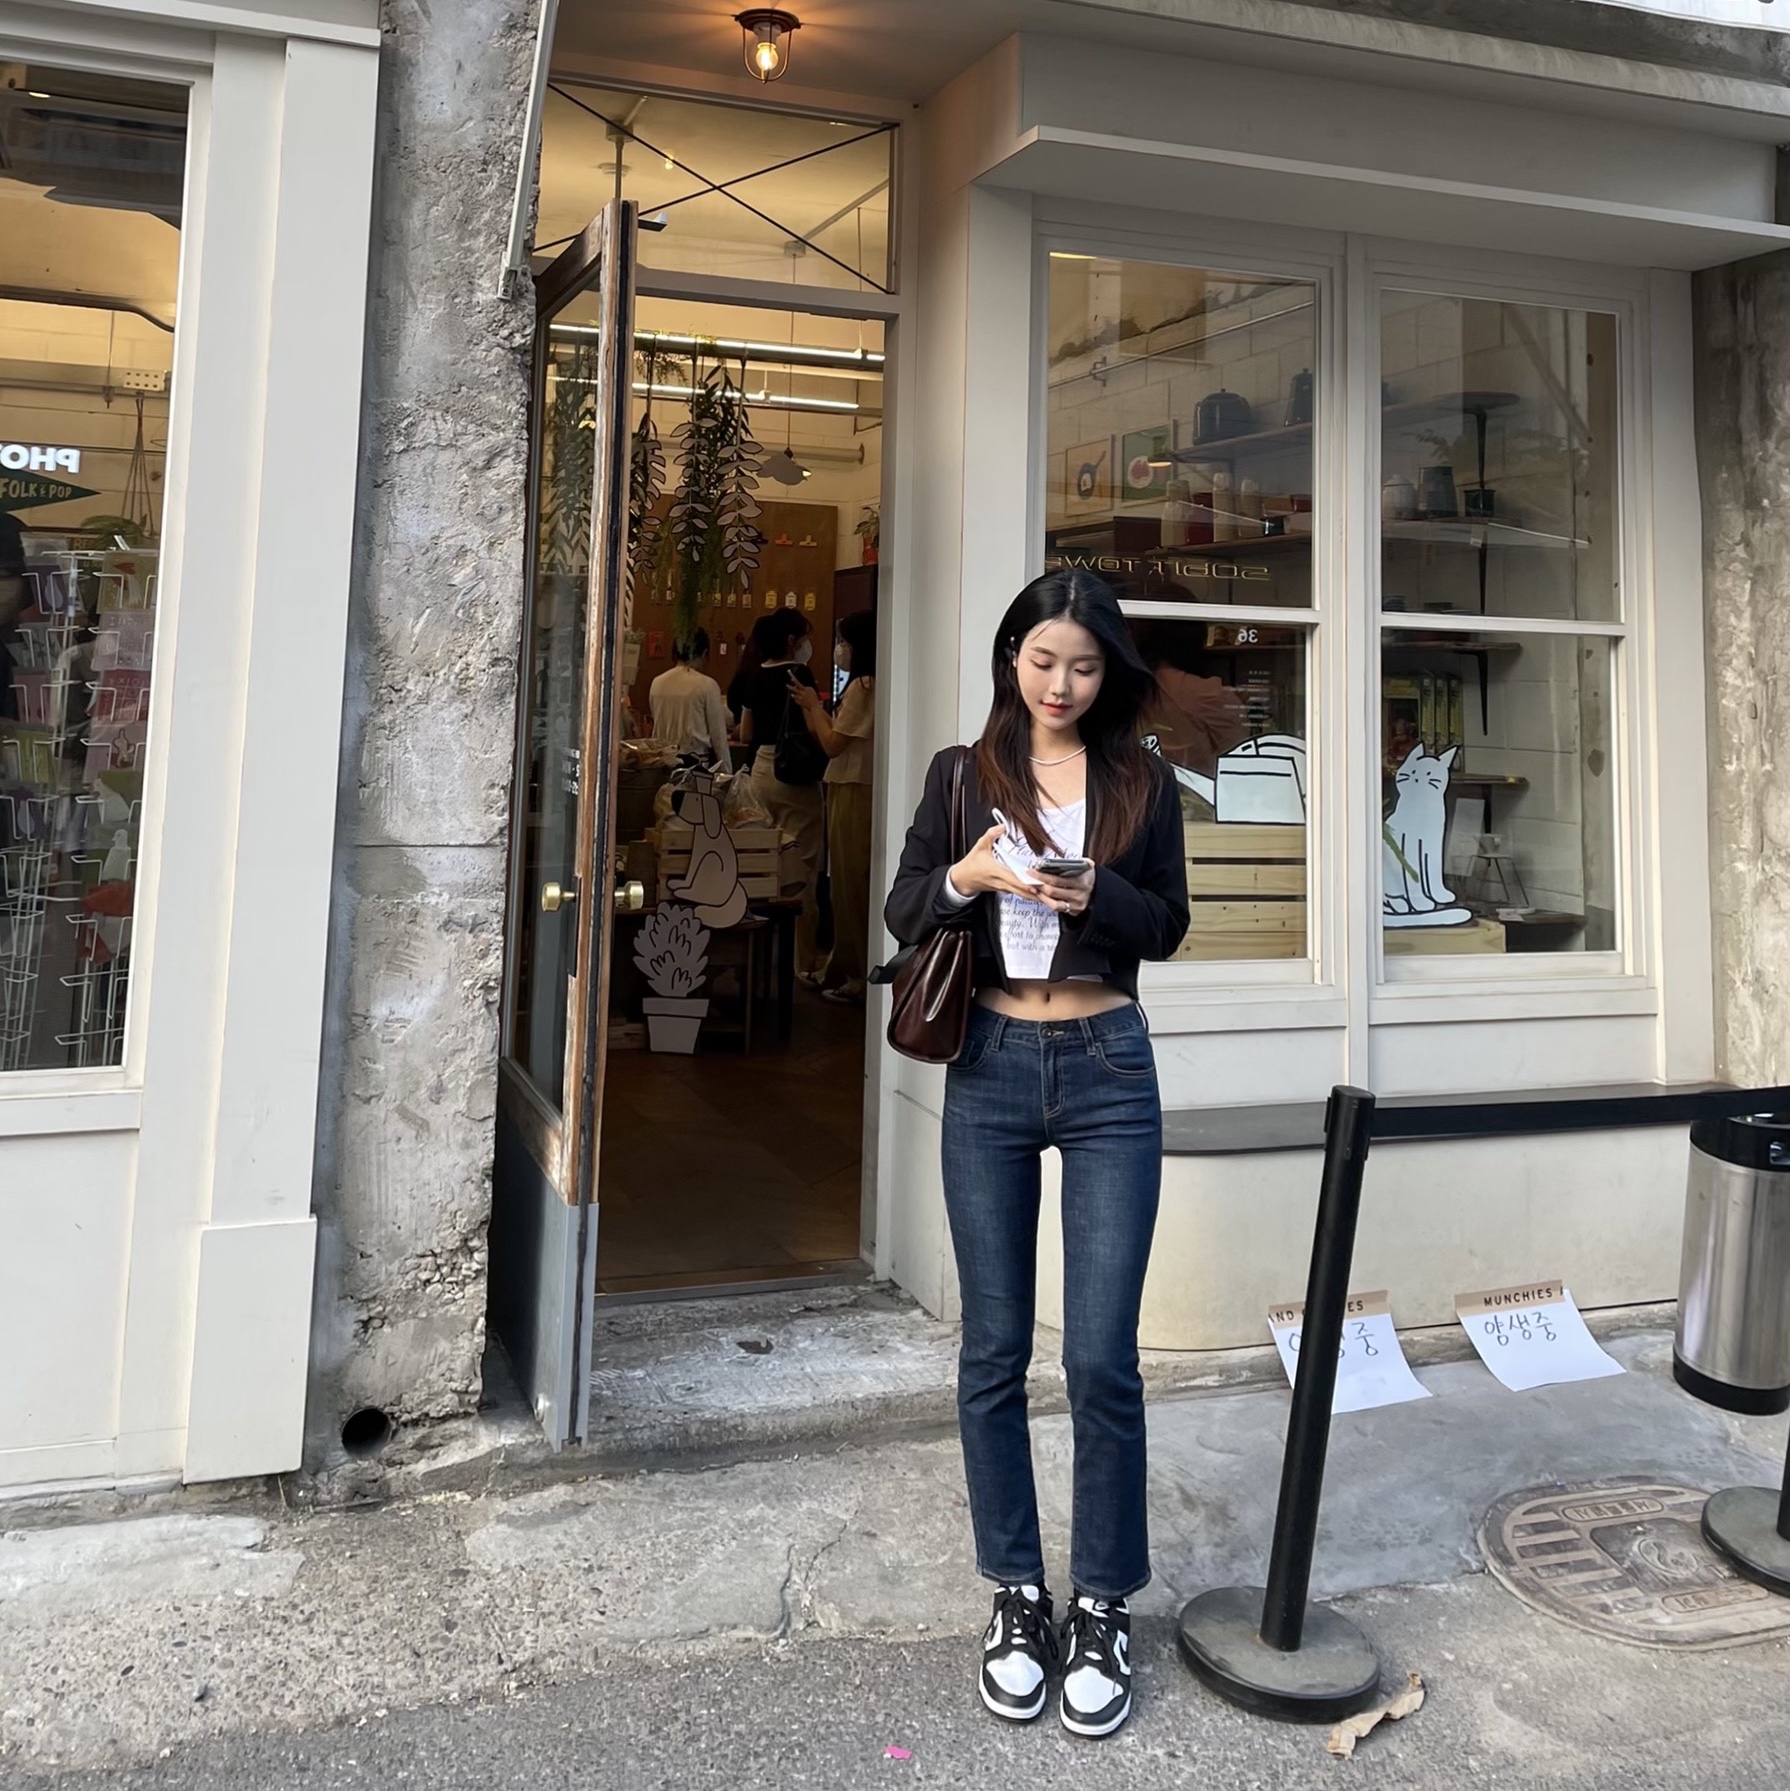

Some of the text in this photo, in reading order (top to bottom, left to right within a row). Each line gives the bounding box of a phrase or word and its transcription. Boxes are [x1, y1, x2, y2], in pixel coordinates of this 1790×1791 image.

[0, 478, 37, 498] FOLK
[48, 484, 72, 498] POP
[1484, 1287, 1552, 1307] MUNCHIES
[1484, 1311, 1557, 1347] 양생중
